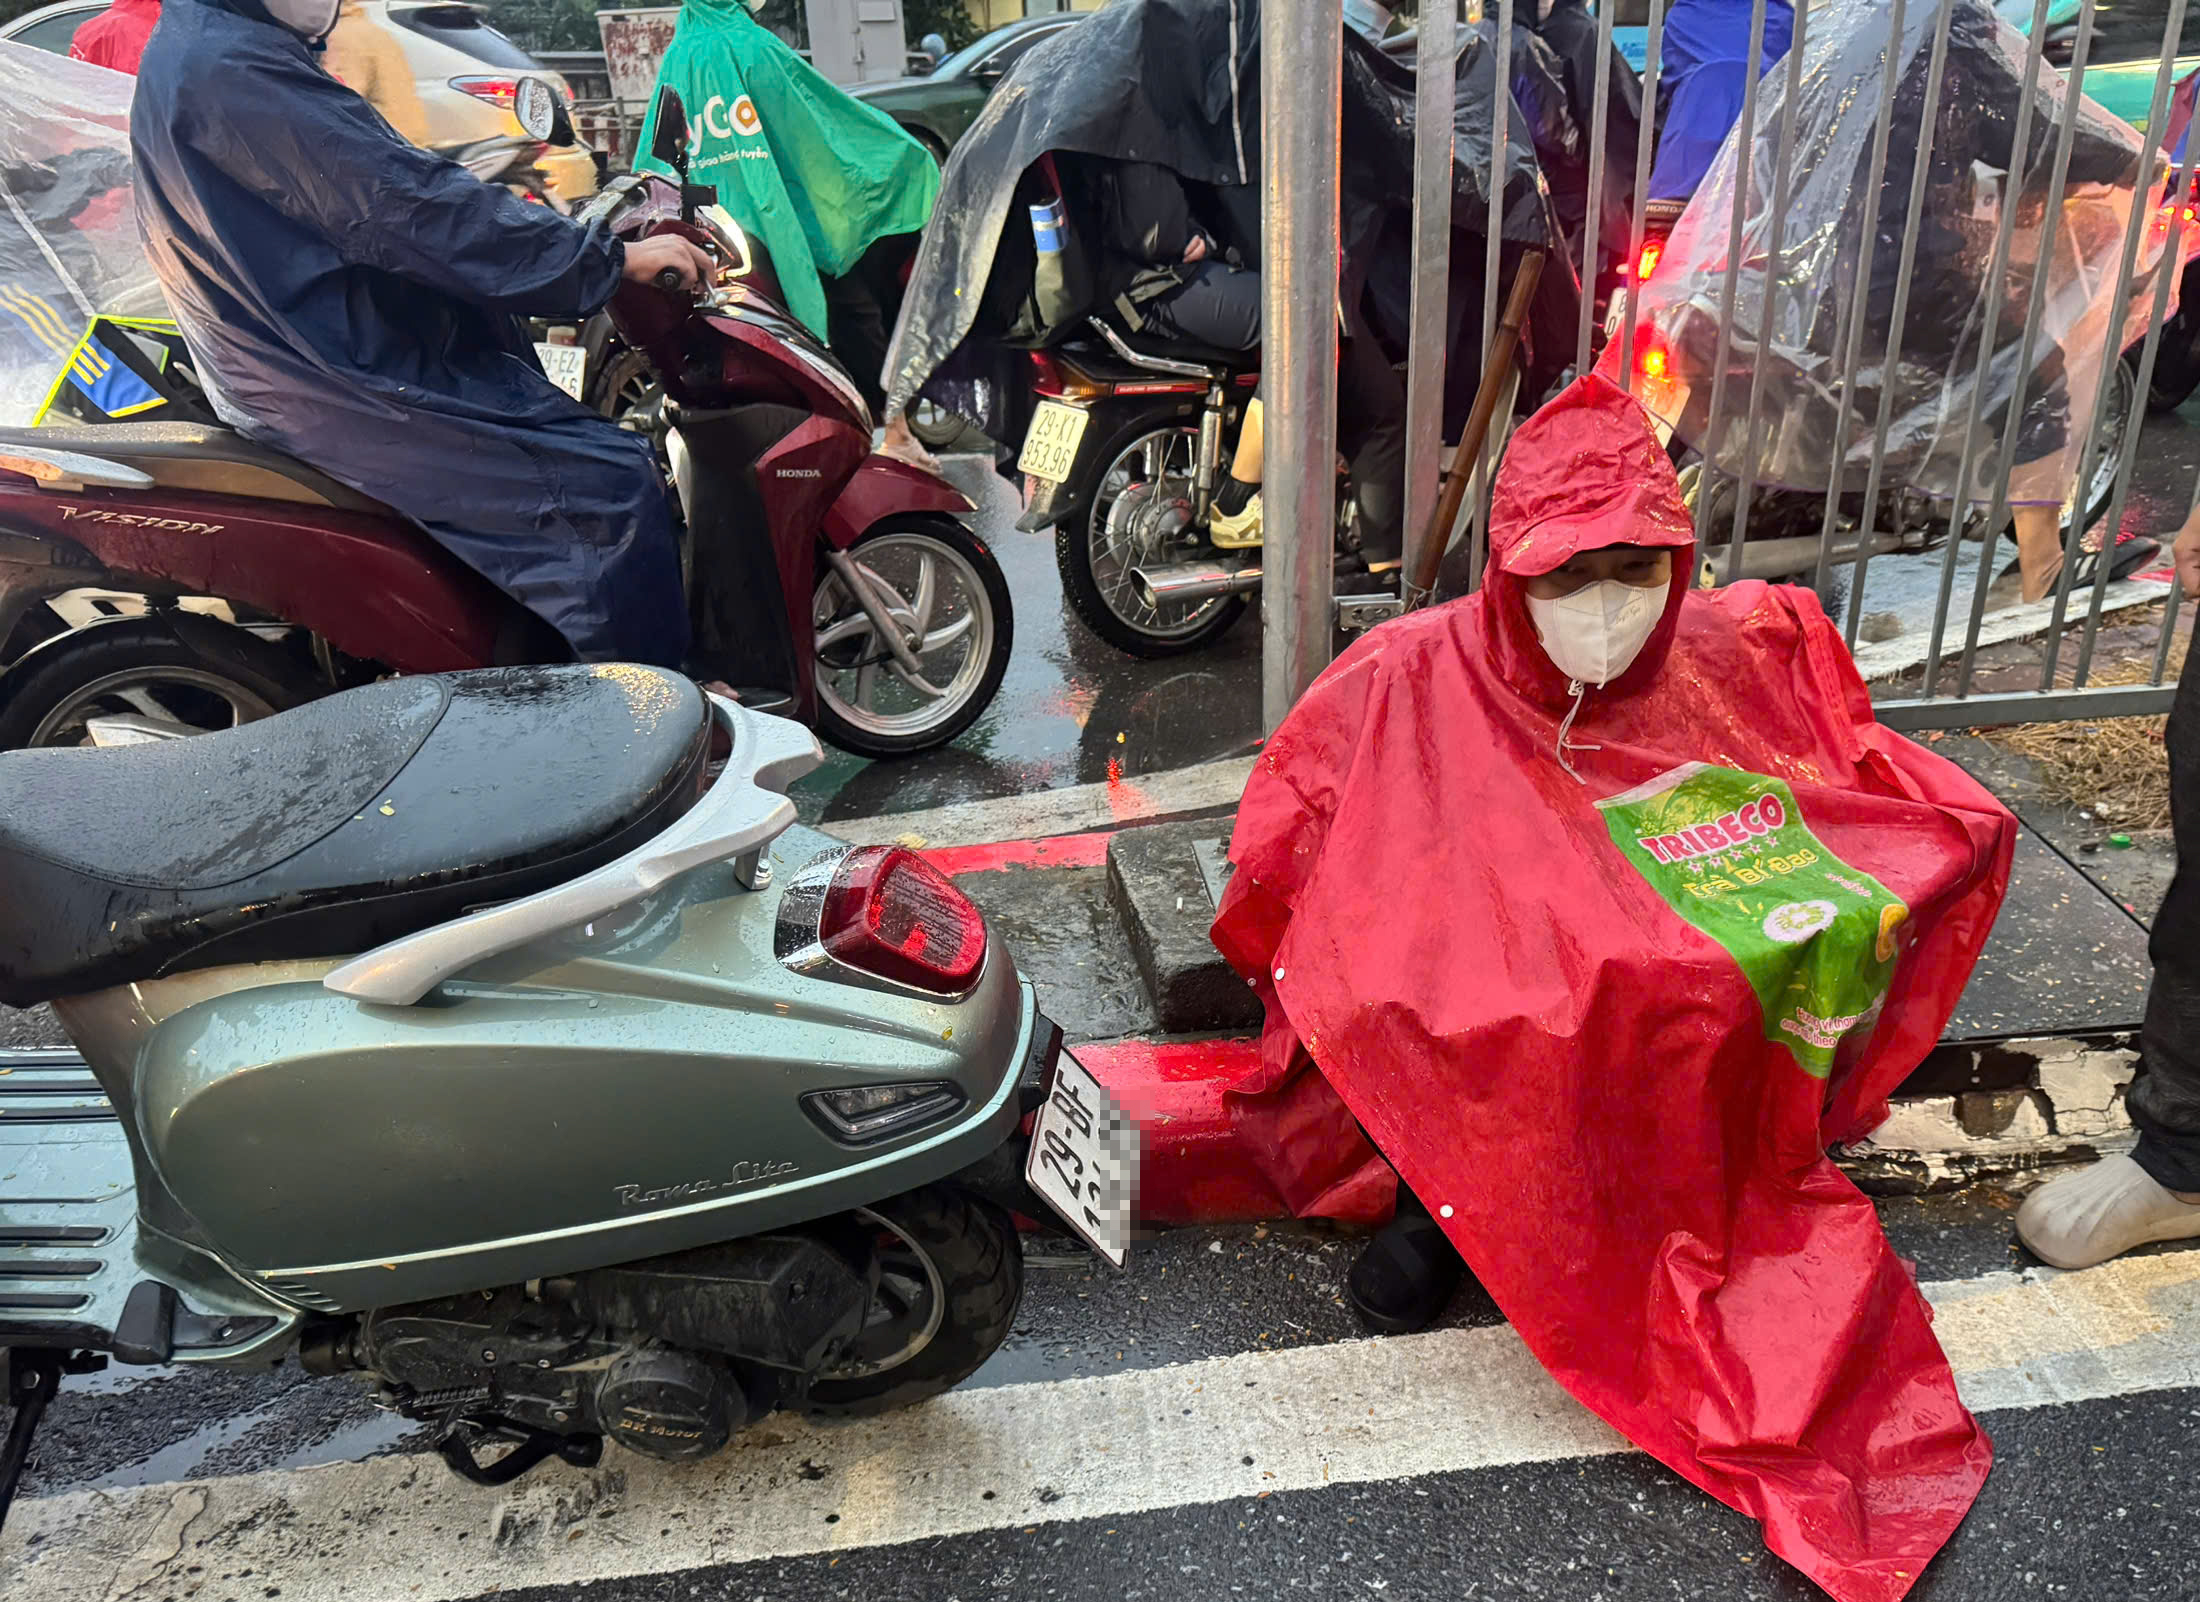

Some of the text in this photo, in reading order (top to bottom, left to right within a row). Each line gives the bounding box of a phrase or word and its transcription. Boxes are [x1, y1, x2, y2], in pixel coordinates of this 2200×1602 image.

[776, 469, 822, 478] HONDA
[1023, 439, 1071, 475] 953.96
[57, 505, 225, 535] VISION
[1638, 793, 1786, 864] TRIBECO
[1041, 1069, 1094, 1200] 29-BF
[613, 1160, 800, 1205] Roma Lite
